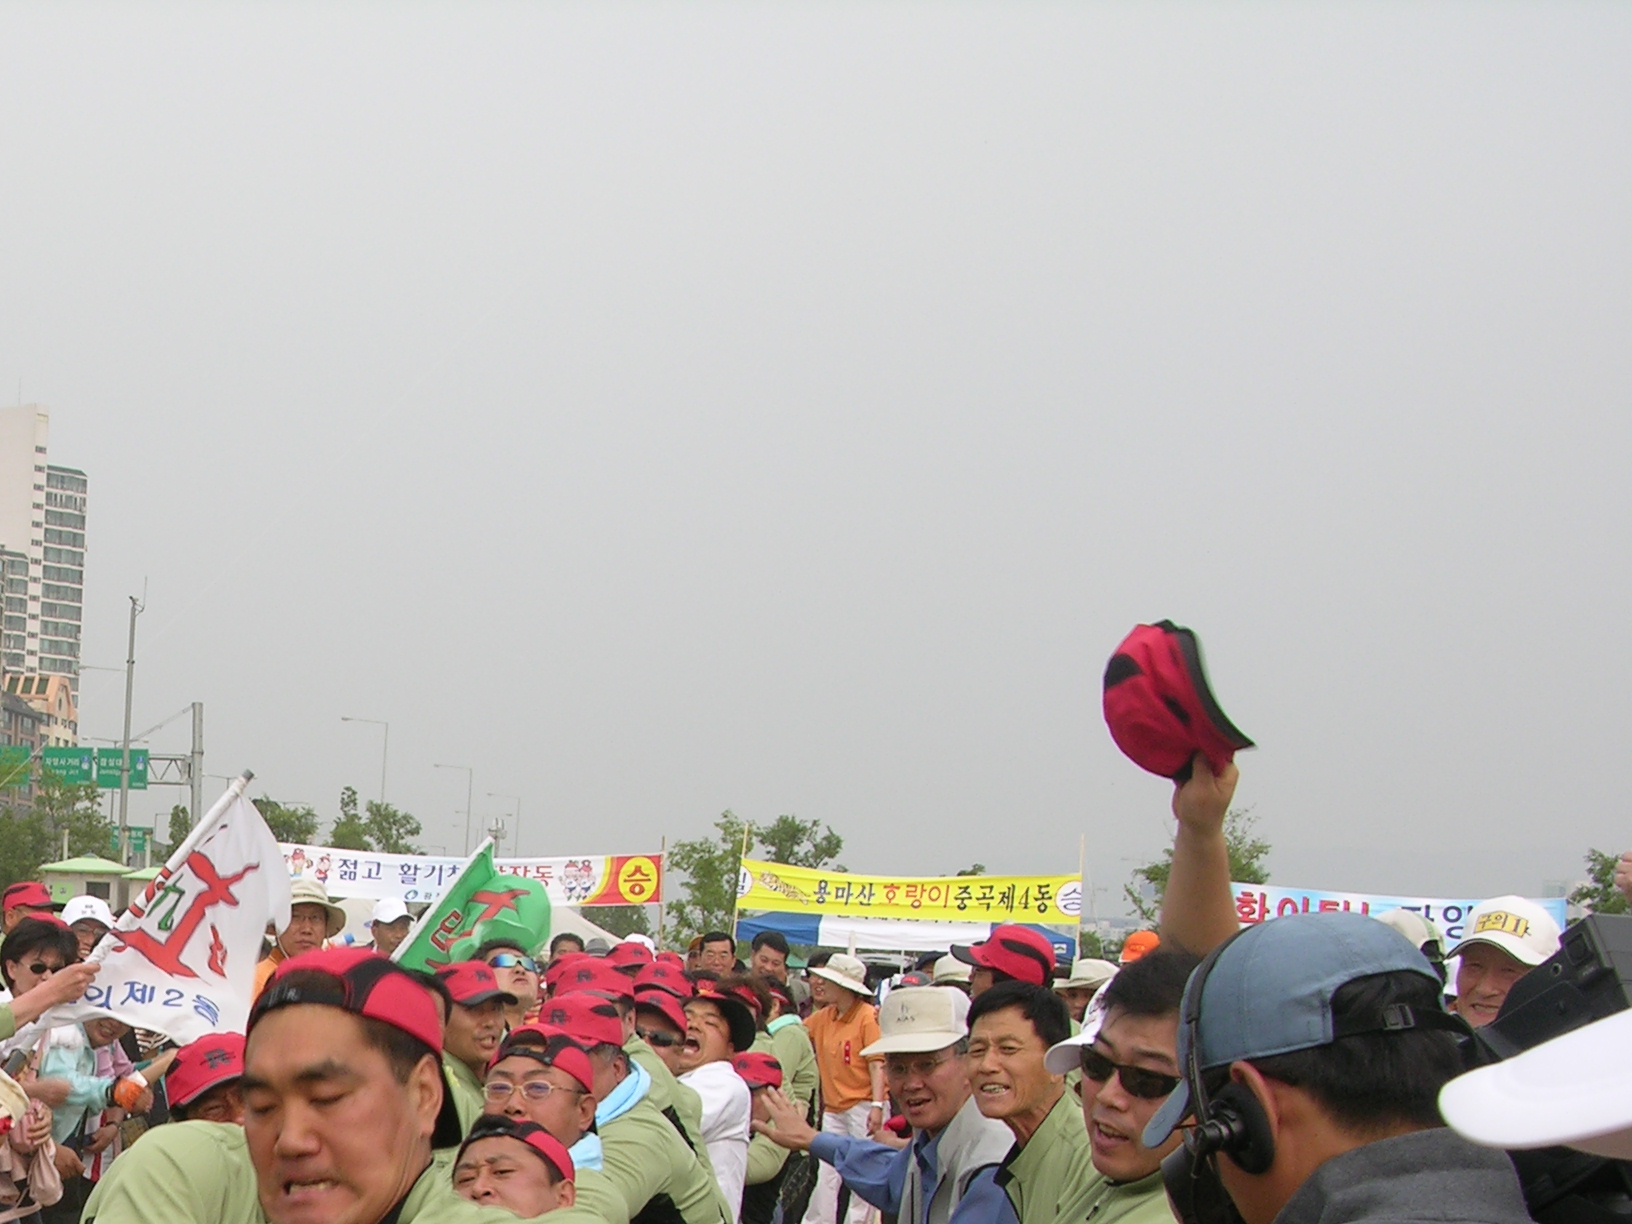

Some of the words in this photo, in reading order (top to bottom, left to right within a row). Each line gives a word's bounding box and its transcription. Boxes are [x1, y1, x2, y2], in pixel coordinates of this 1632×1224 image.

[338, 858, 382, 881] 젊고
[623, 865, 652, 896] 승
[813, 879, 875, 906] 용마산
[879, 883, 950, 909] 호랑이
[954, 883, 1053, 914] 중곡제4동
